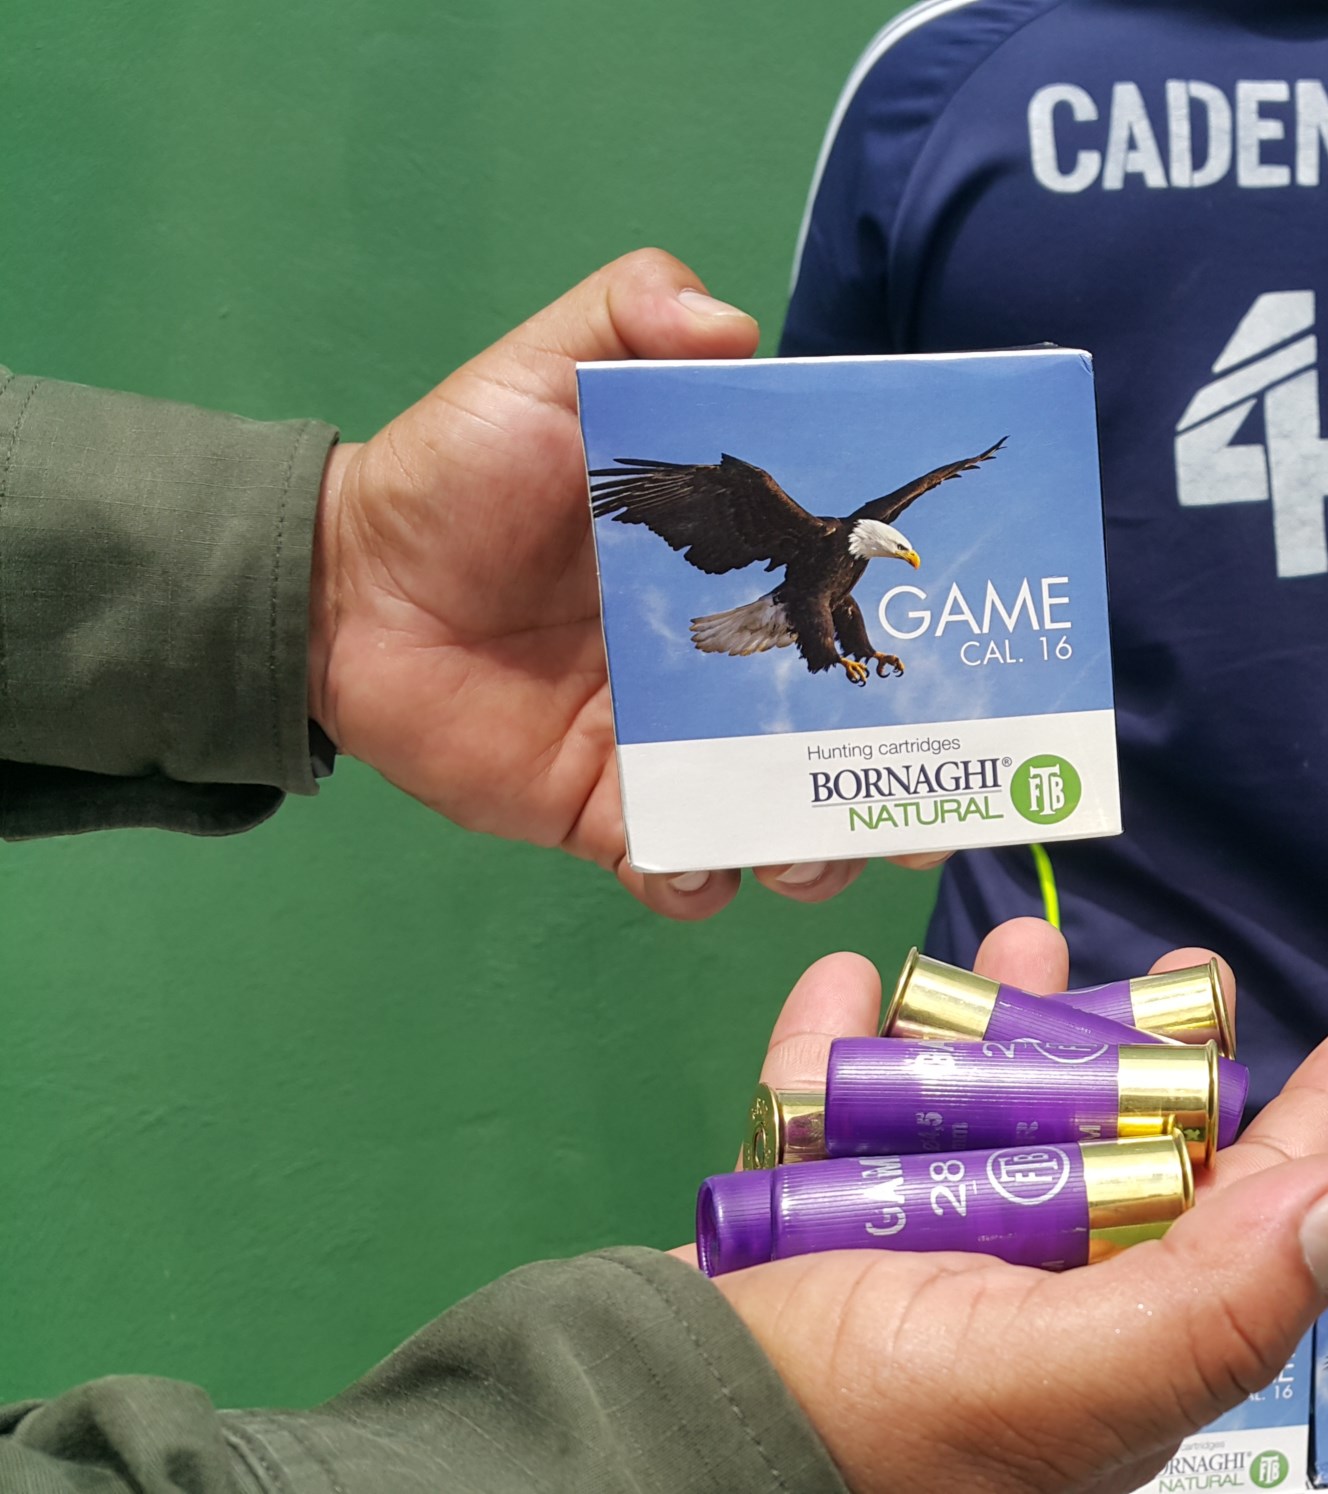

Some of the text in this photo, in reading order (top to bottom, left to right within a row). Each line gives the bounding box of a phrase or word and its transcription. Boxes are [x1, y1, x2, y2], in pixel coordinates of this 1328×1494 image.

[878, 576, 1072, 640] GAME
[960, 635, 1073, 666] CAL. 16
[807, 737, 961, 760] Hunting cartridges
[849, 796, 1005, 832] NATURAL
[858, 1154, 907, 1236] GAM
[929, 1159, 968, 1217] 28
[1273, 1384, 1294, 1400] 16
[1160, 1451, 1245, 1476] RNAGHI
[1159, 1474, 1245, 1493] NATURAL
